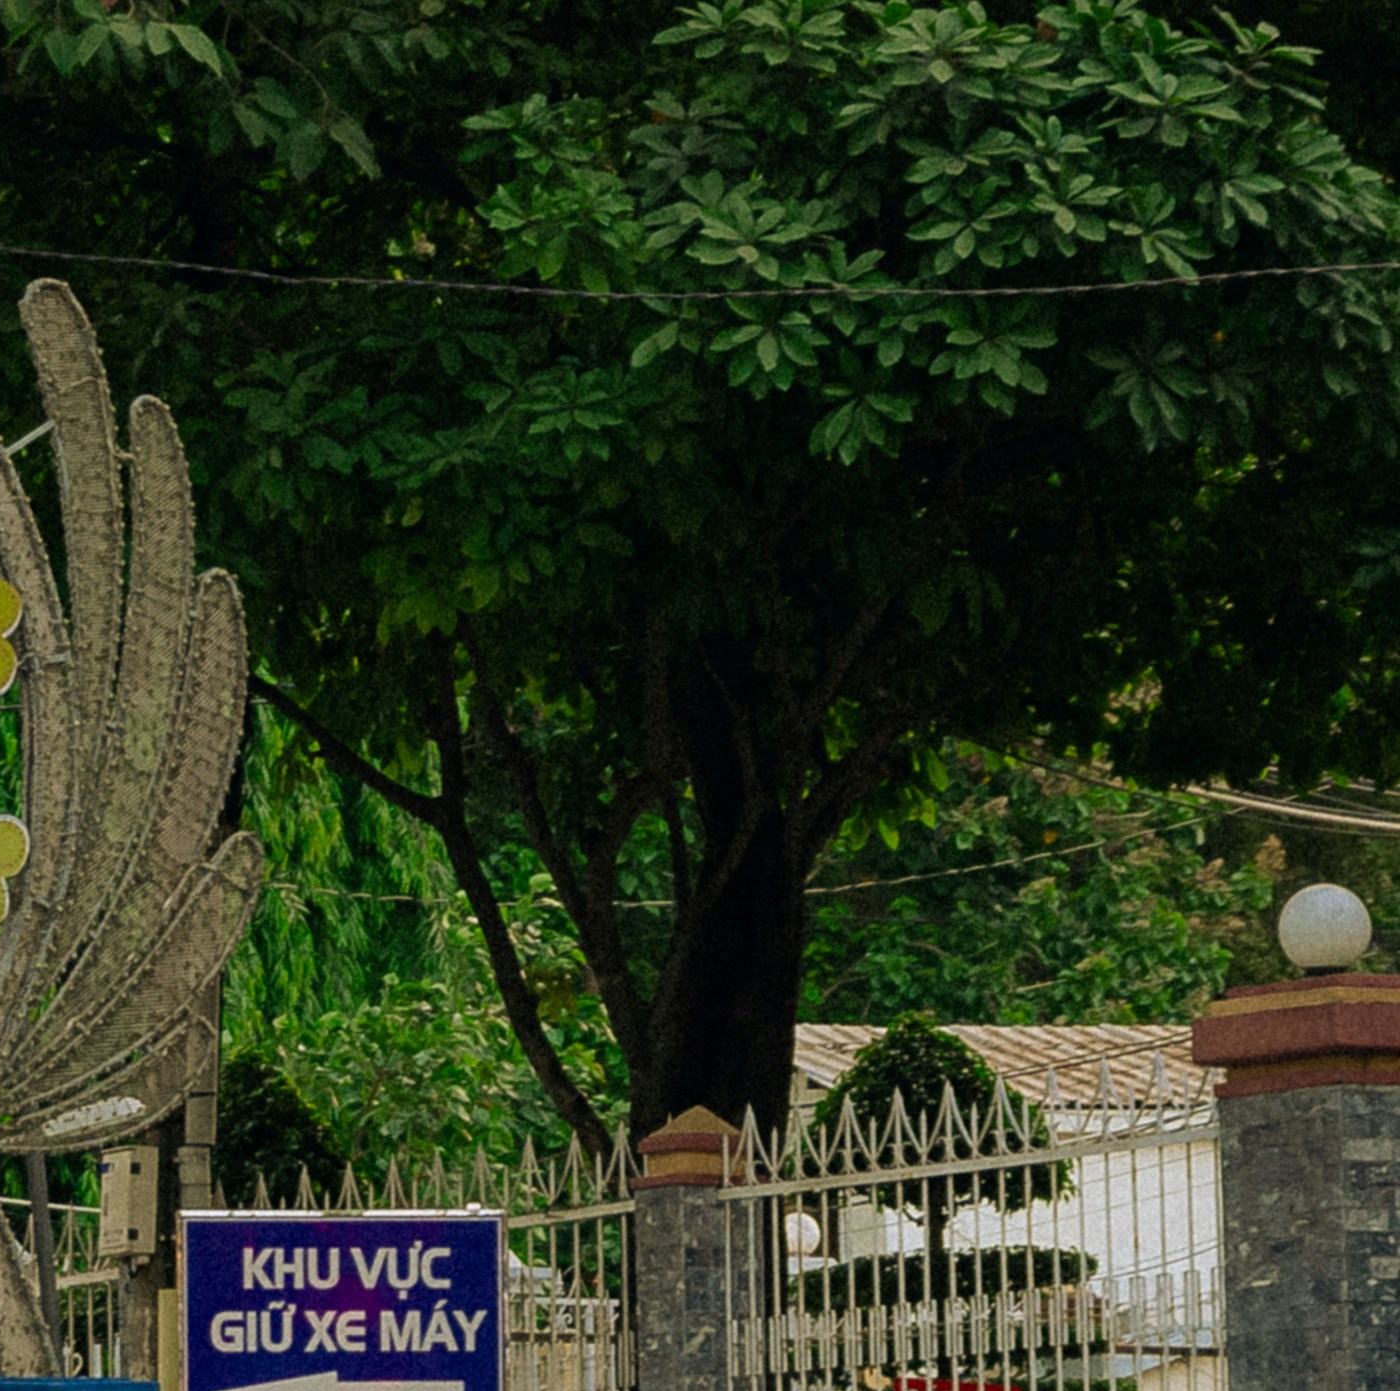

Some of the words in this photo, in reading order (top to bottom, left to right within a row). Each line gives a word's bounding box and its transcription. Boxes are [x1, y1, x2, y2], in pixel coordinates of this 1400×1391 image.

[242, 1247, 341, 1291] KHU
[350, 1240, 452, 1301] VỰC
[210, 1300, 297, 1353] GIỮ
[304, 1310, 367, 1353] XE
[379, 1299, 488, 1353] MÁY
